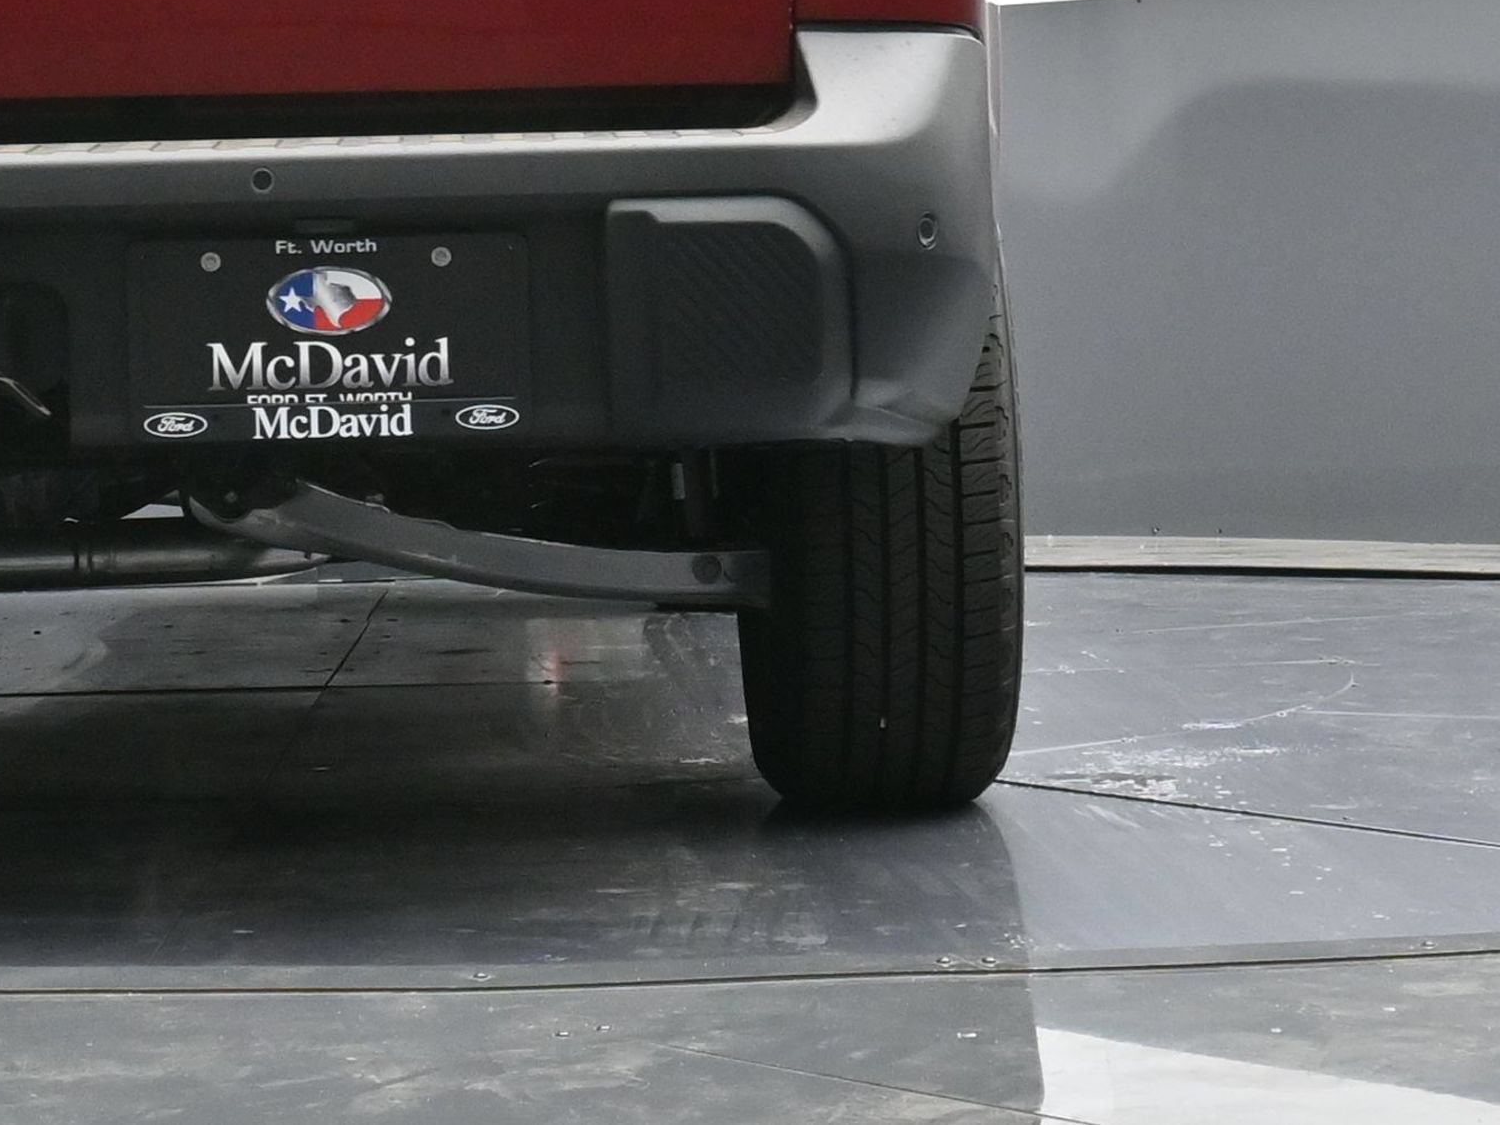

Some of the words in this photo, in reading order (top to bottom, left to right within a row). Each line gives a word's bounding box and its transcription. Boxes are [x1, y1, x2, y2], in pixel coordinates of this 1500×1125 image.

[275, 240, 302, 254] Ft.
[310, 238, 377, 254] Worth
[207, 336, 454, 392] McDavid
[157, 416, 195, 432] Ford
[252, 403, 414, 439] McDavid
[469, 408, 507, 424] Ford
